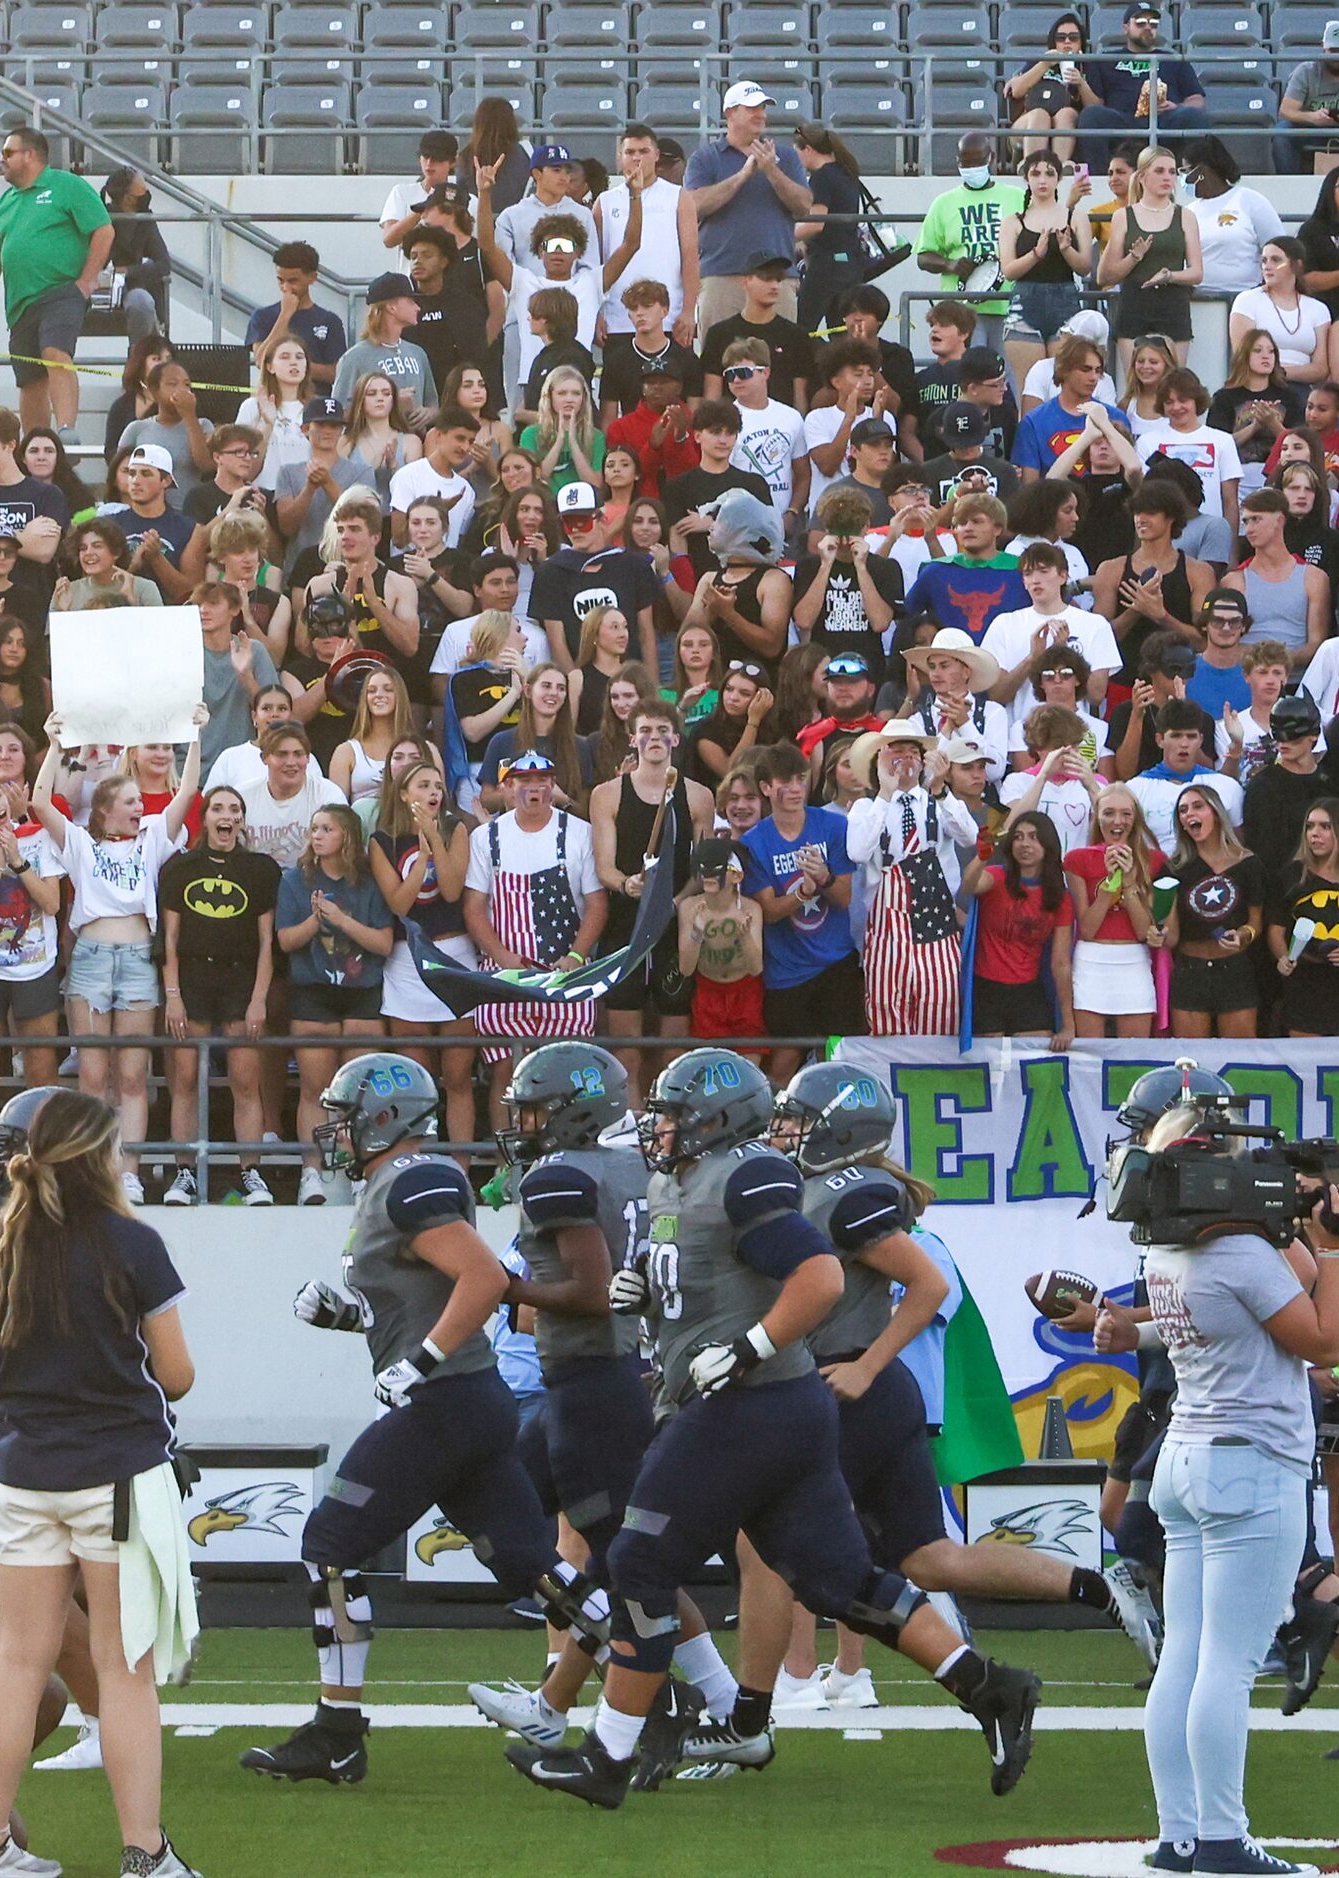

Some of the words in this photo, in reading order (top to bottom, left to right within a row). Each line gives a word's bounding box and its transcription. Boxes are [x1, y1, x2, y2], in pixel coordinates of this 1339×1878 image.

[958, 203, 1001, 226] WE
[961, 225, 1001, 243] ARE
[577, 597, 614, 616] NIKE
[705, 918, 738, 939] GO
[370, 1064, 414, 1098] 66
[570, 1066, 606, 1099] 12
[703, 1061, 742, 1097] 70
[825, 1169, 867, 1192] 60
[1254, 1180, 1284, 1188] Panasonic
